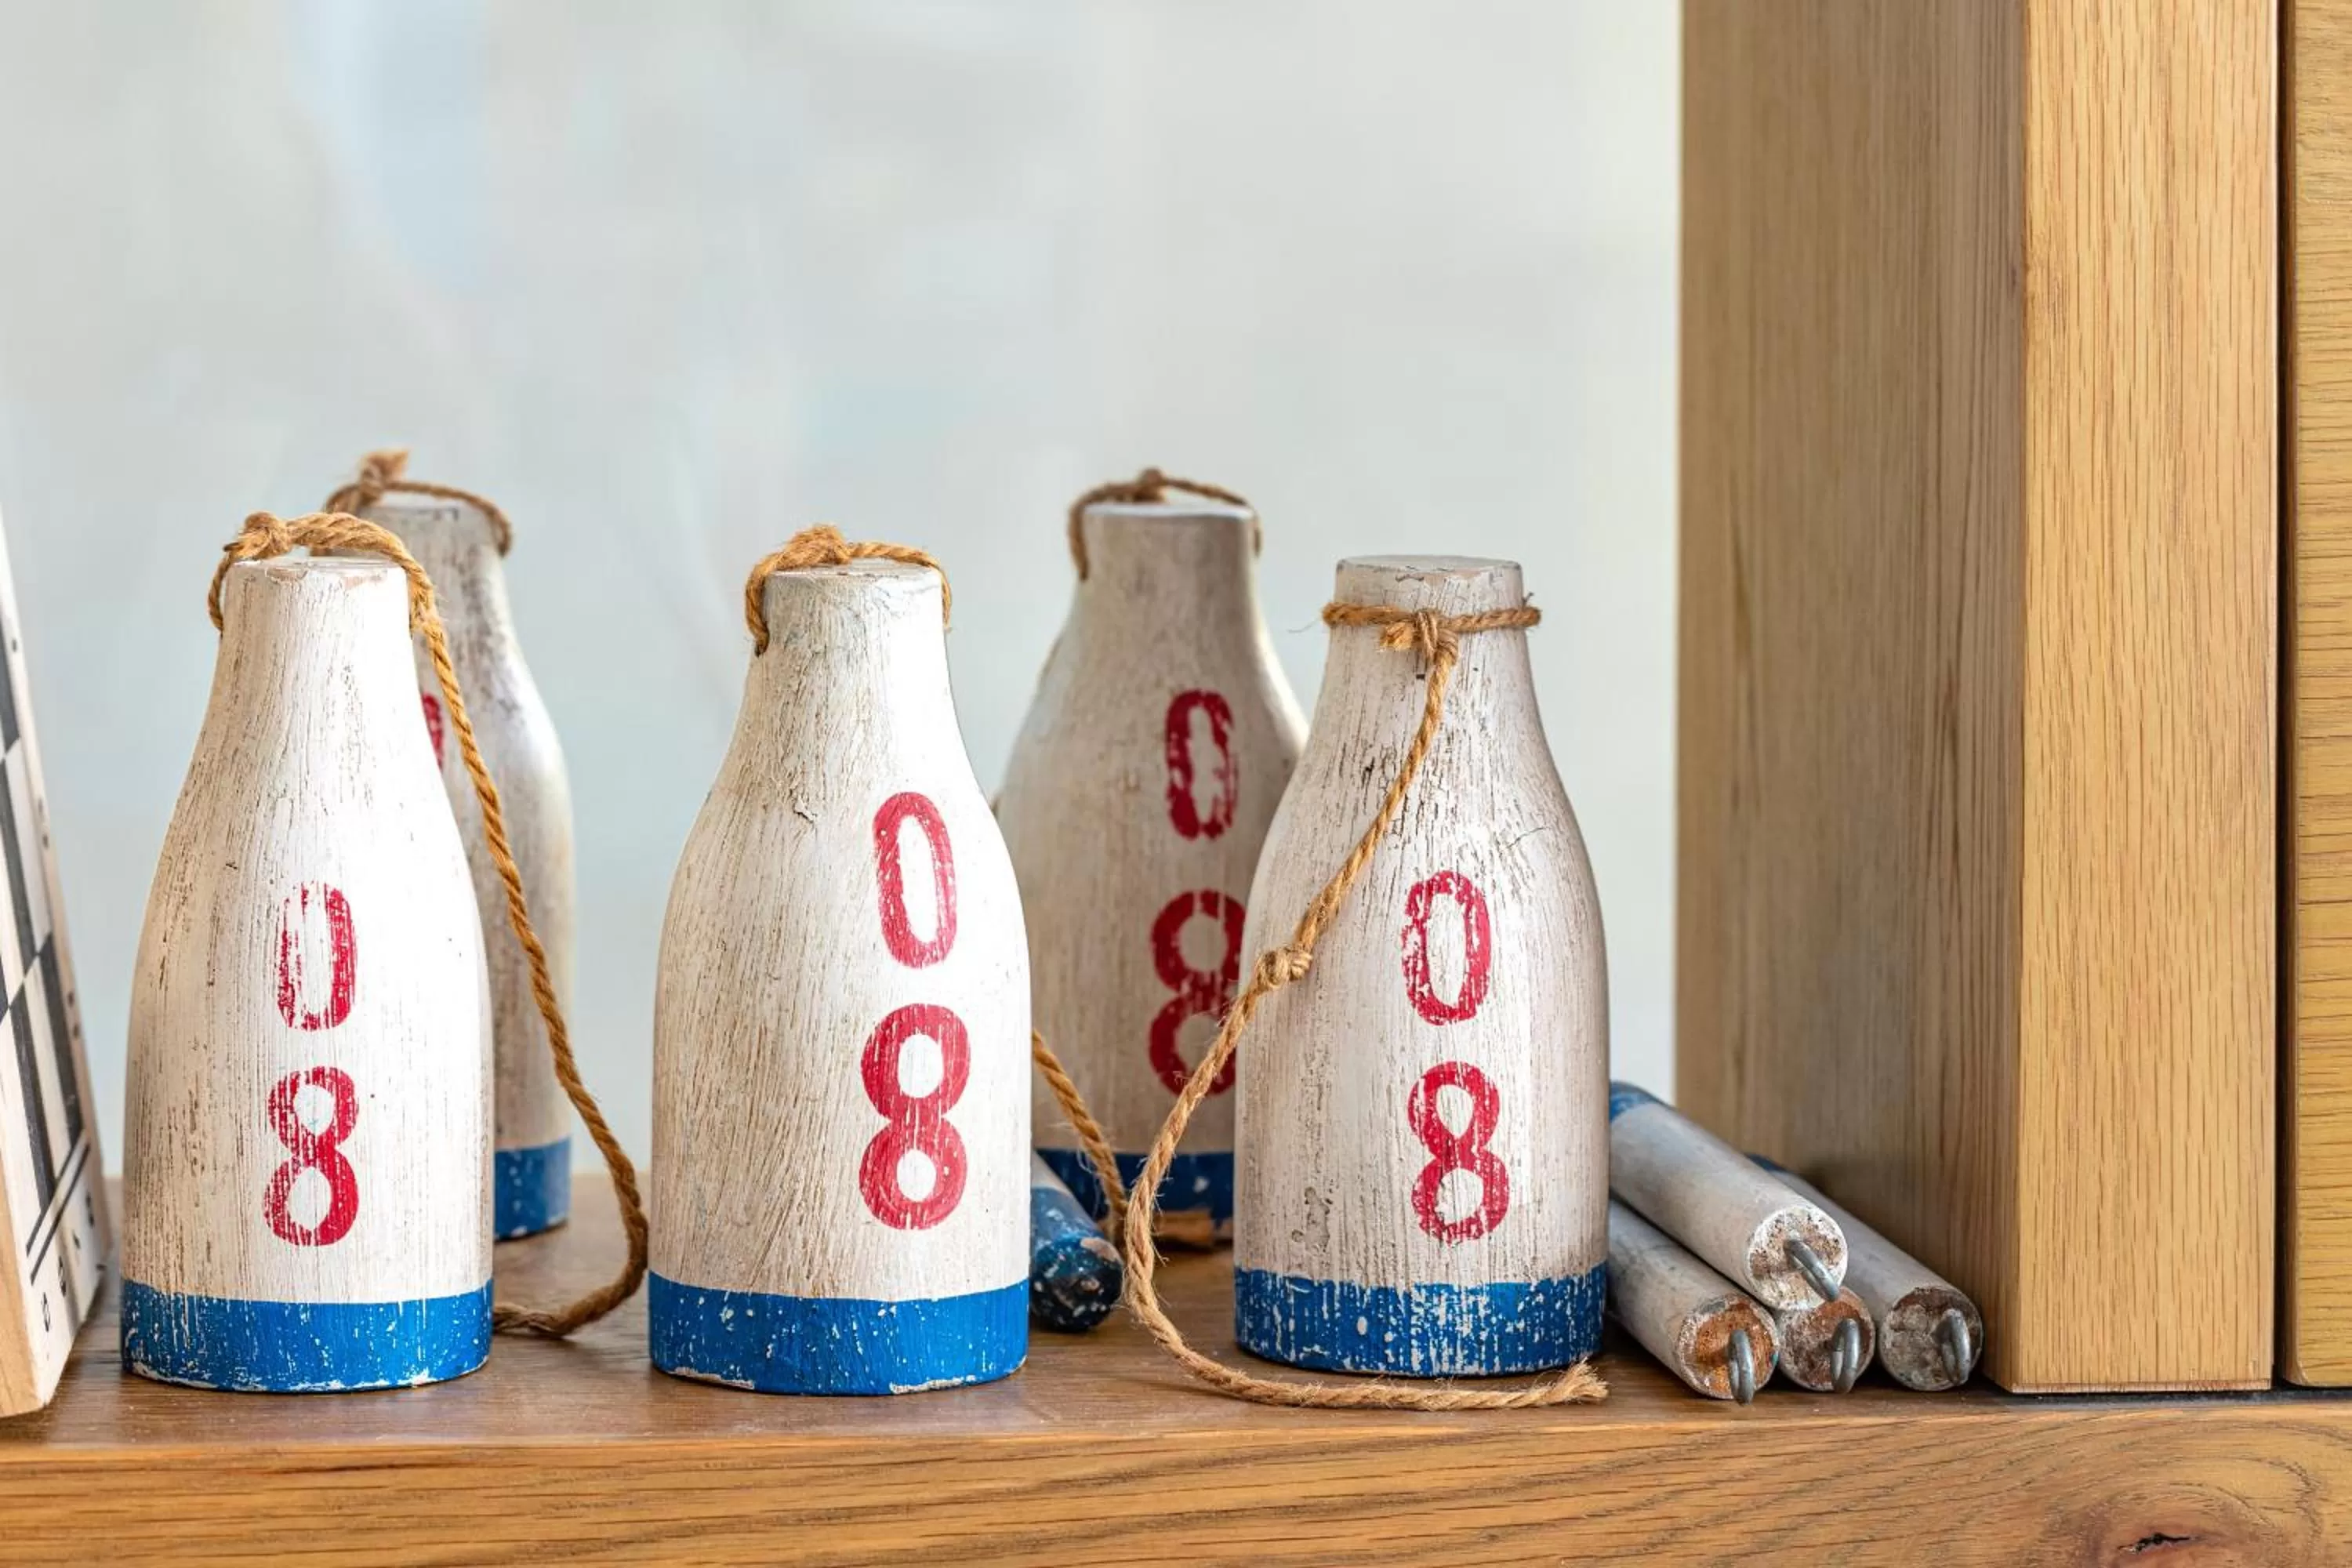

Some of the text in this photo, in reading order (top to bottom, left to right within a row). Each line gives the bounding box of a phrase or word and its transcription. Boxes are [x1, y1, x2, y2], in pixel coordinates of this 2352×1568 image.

[263, 880, 359, 1247] 08
[858, 792, 971, 1230] 08
[1149, 690, 1246, 1096] 08
[1401, 870, 1509, 1246] 08
